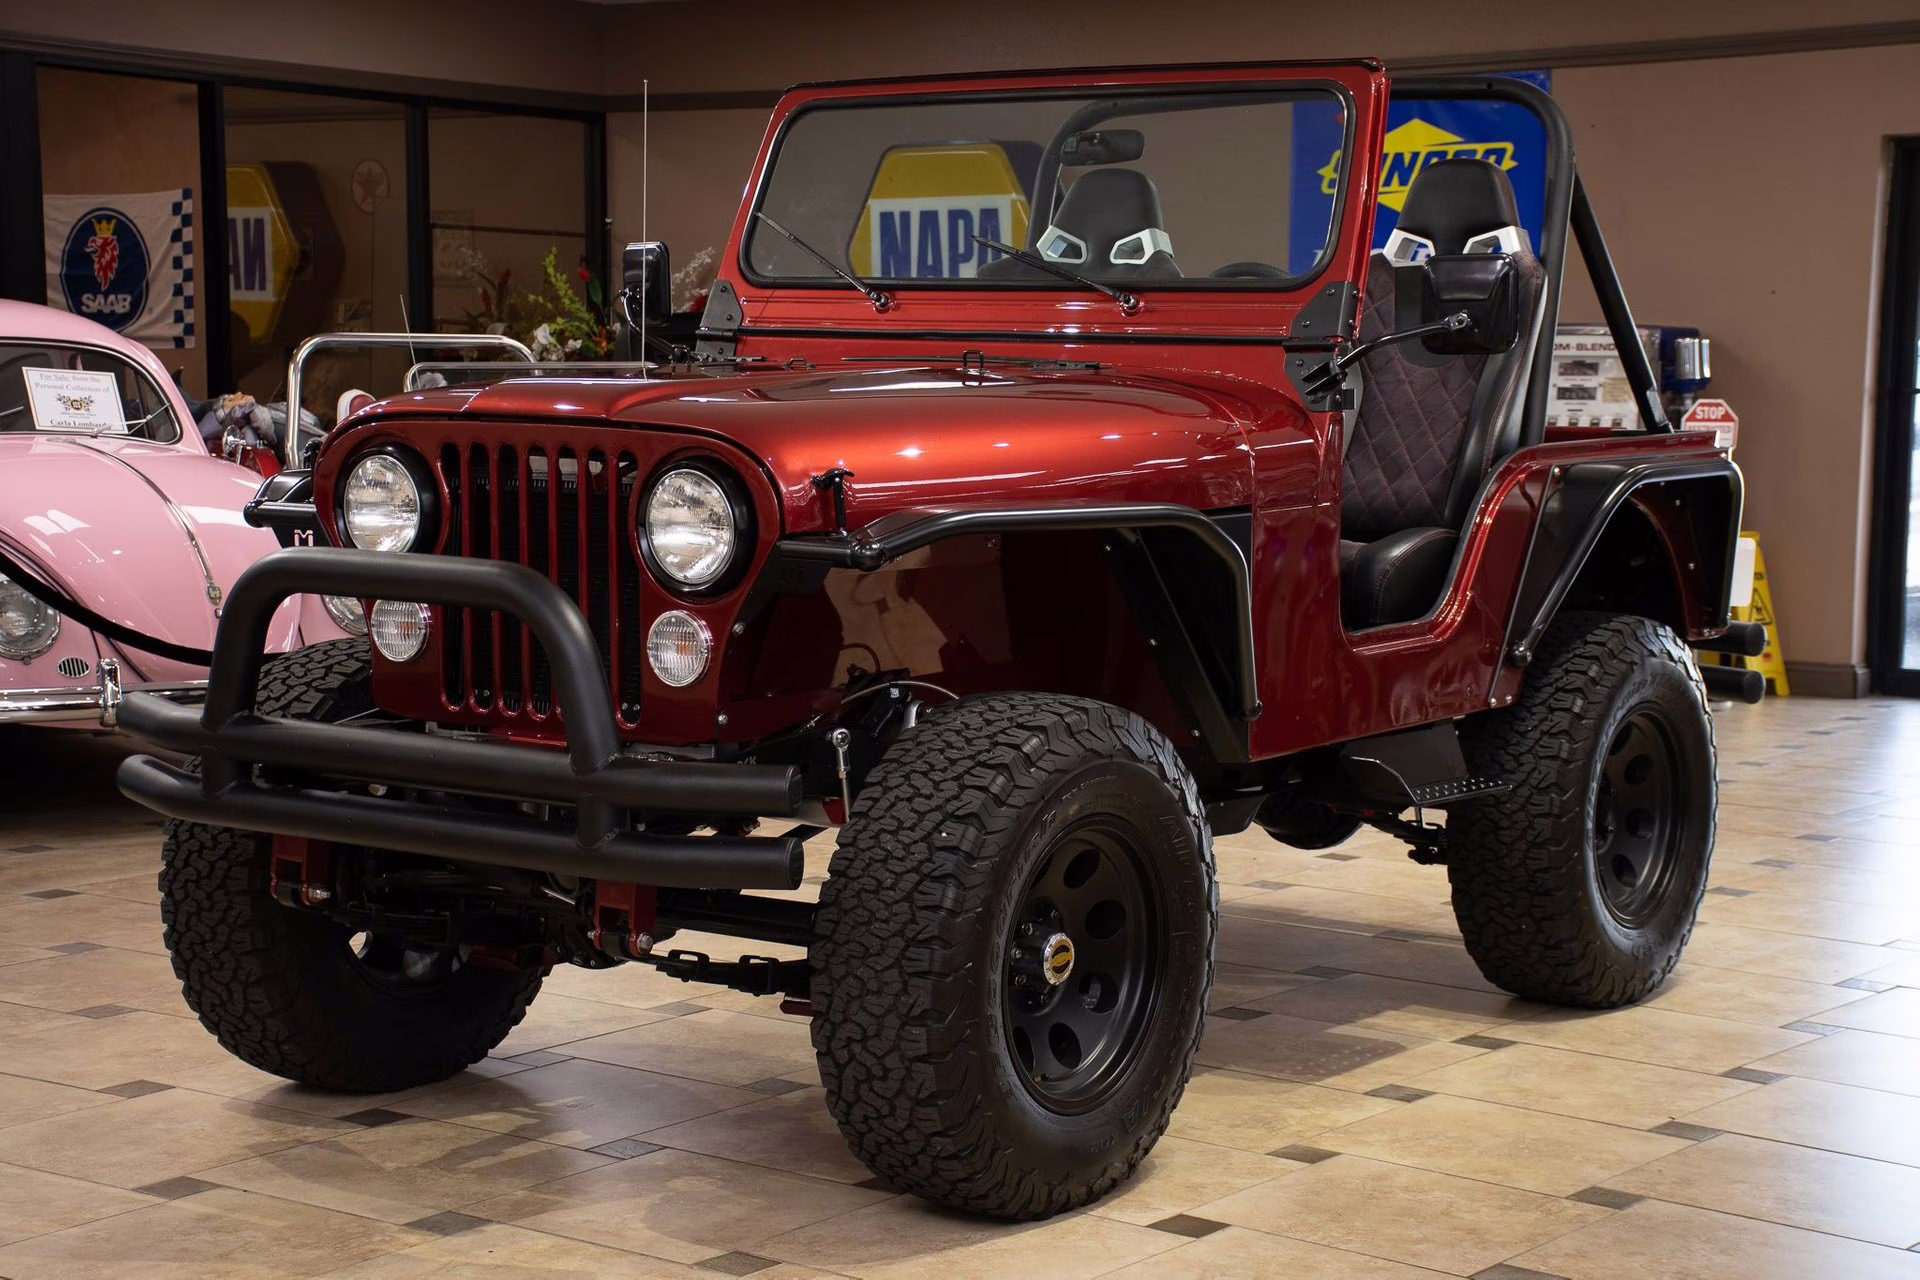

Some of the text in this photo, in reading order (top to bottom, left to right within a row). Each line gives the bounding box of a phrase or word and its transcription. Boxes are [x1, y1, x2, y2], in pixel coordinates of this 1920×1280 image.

[880, 208, 1002, 278] NAPA
[81, 293, 132, 314] SAAB
[66, 384, 100, 392] Collection
[1695, 406, 1726, 420] STOP
